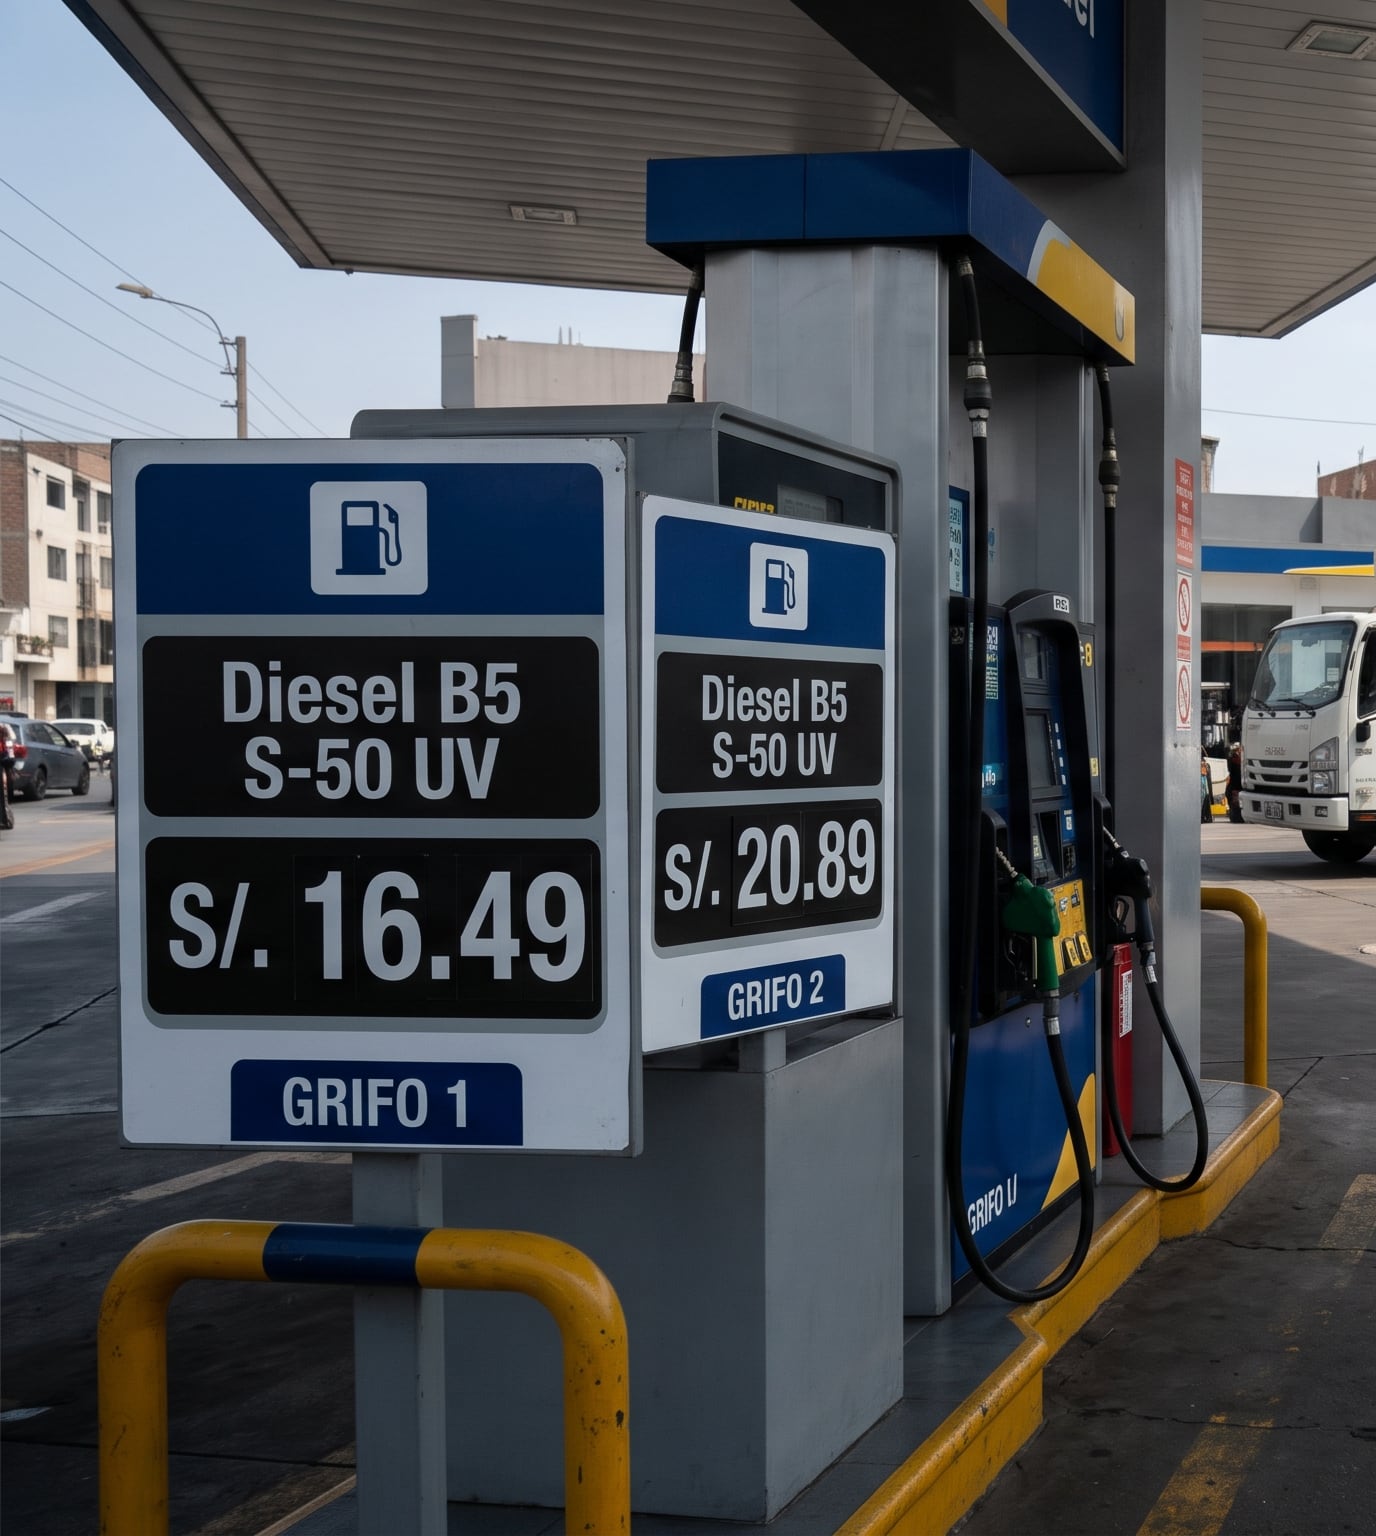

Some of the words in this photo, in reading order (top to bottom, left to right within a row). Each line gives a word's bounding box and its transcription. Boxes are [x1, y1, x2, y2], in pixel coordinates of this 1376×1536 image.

[223, 660, 415, 724] Diesel
[440, 662, 521, 724] B5
[702, 674, 800, 722] Diesel
[811, 680, 848, 722] B5
[244, 736, 393, 800] S-50
[414, 738, 500, 800] UV
[712, 731, 787, 779] S-50
[797, 733, 837, 775] UV
[663, 841, 720, 912] S/.
[737, 818, 876, 910] 20.89
[169, 882, 268, 969] S/.
[303, 870, 586, 983] 16.49
[727, 974, 802, 1019] GRIFO
[809, 969, 824, 1005] 2
[282, 1076, 428, 1128] GRIFO
[446, 1079, 467, 1128] 1
[967, 1184, 1003, 1235] GRIFO
